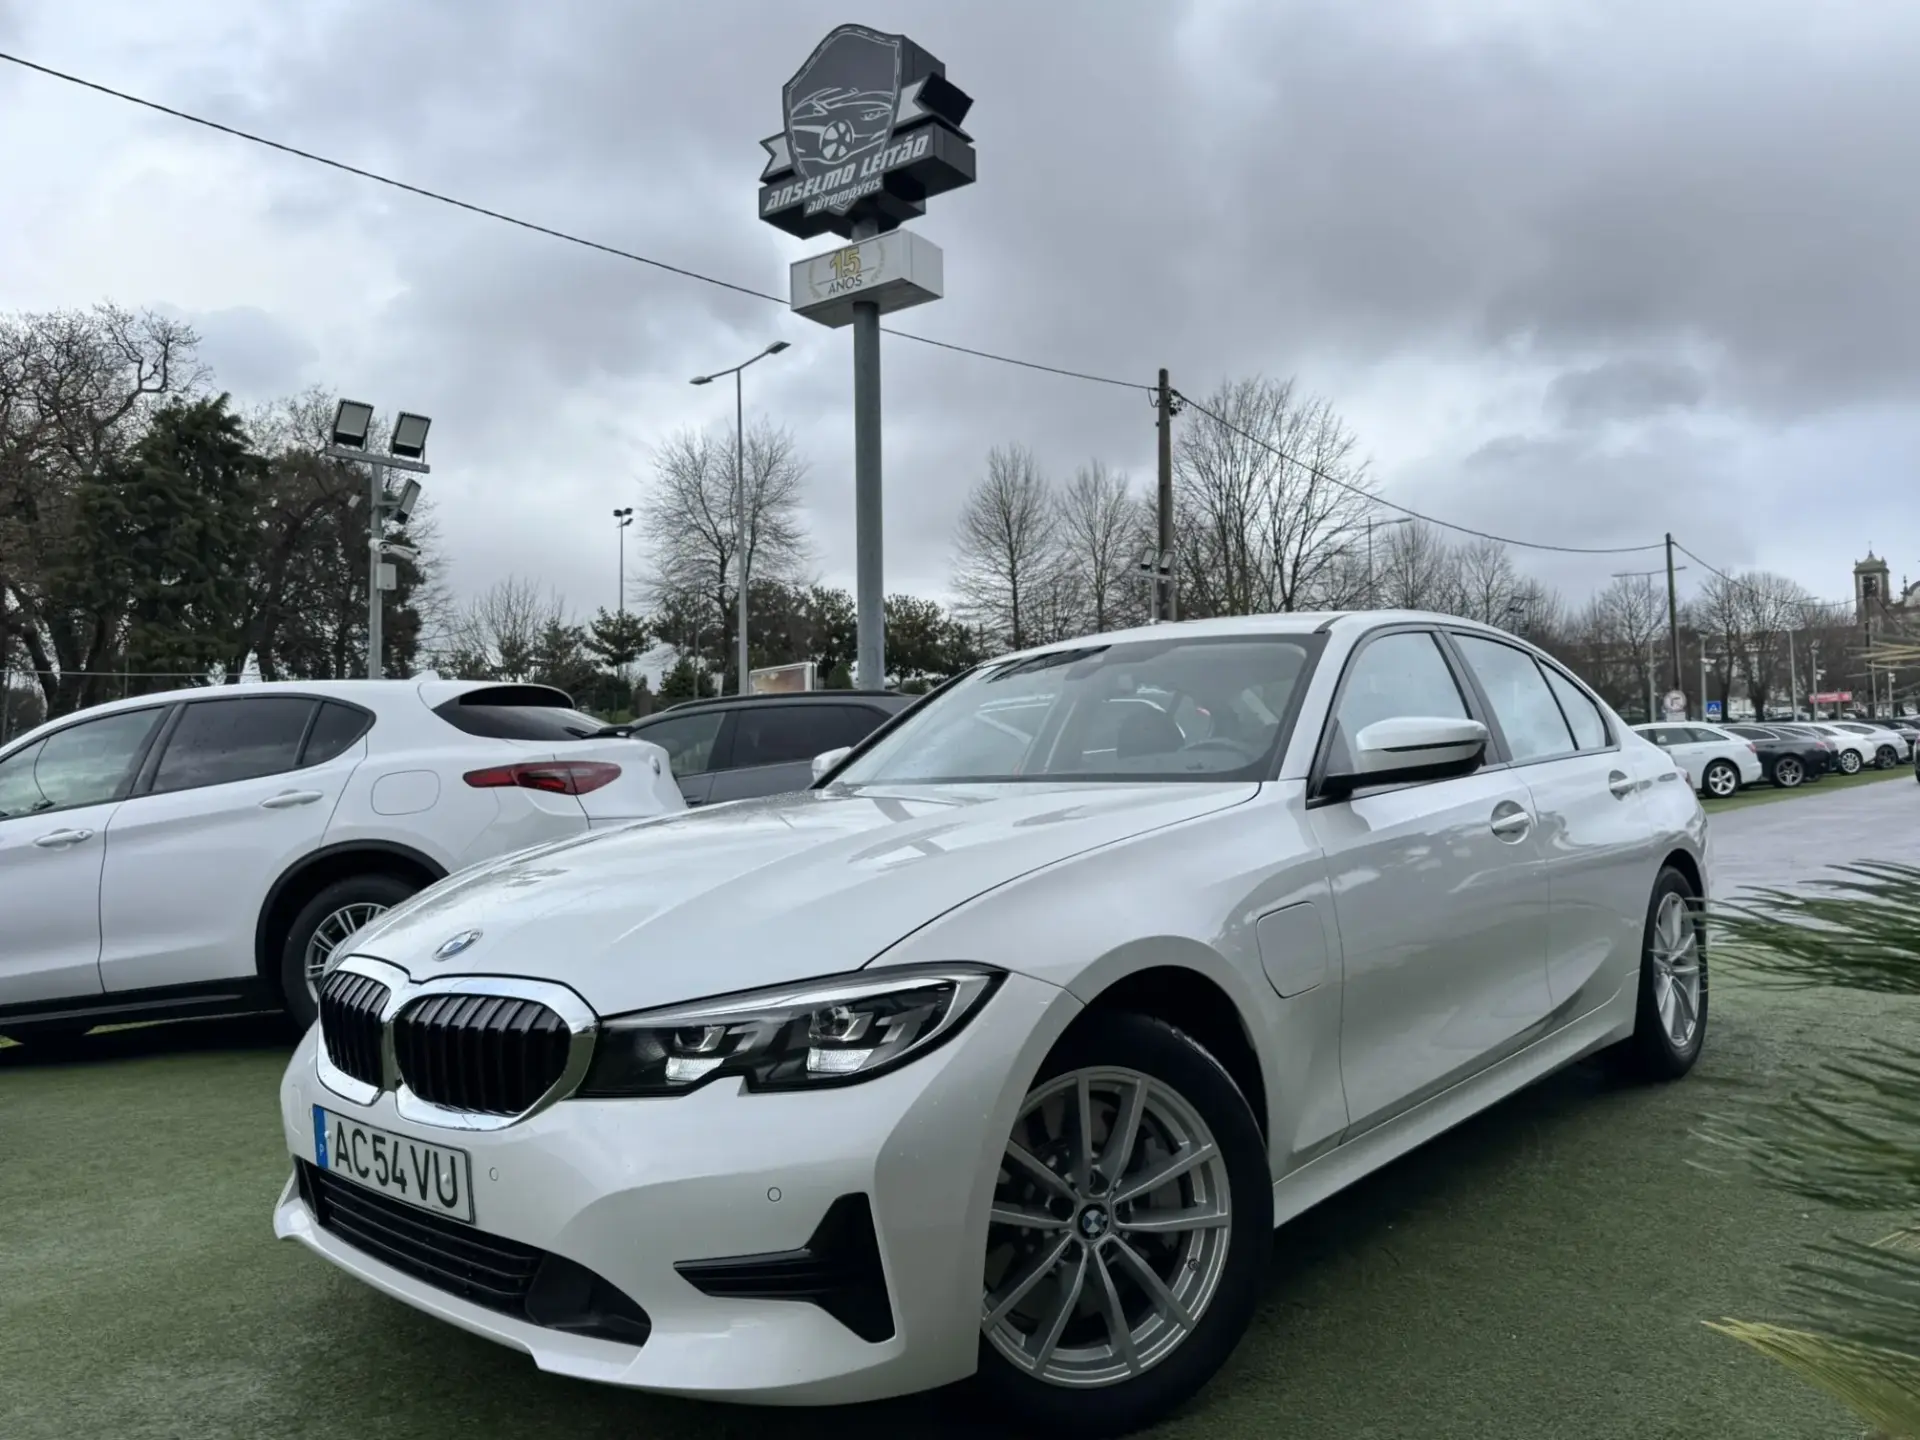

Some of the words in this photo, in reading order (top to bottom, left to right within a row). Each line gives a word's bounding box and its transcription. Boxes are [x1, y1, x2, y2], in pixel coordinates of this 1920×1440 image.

[764, 162, 857, 212] ANSELMO
[860, 134, 930, 178] LEITÃO
[829, 247, 861, 280] 15
[827, 274, 863, 296] ANOS
